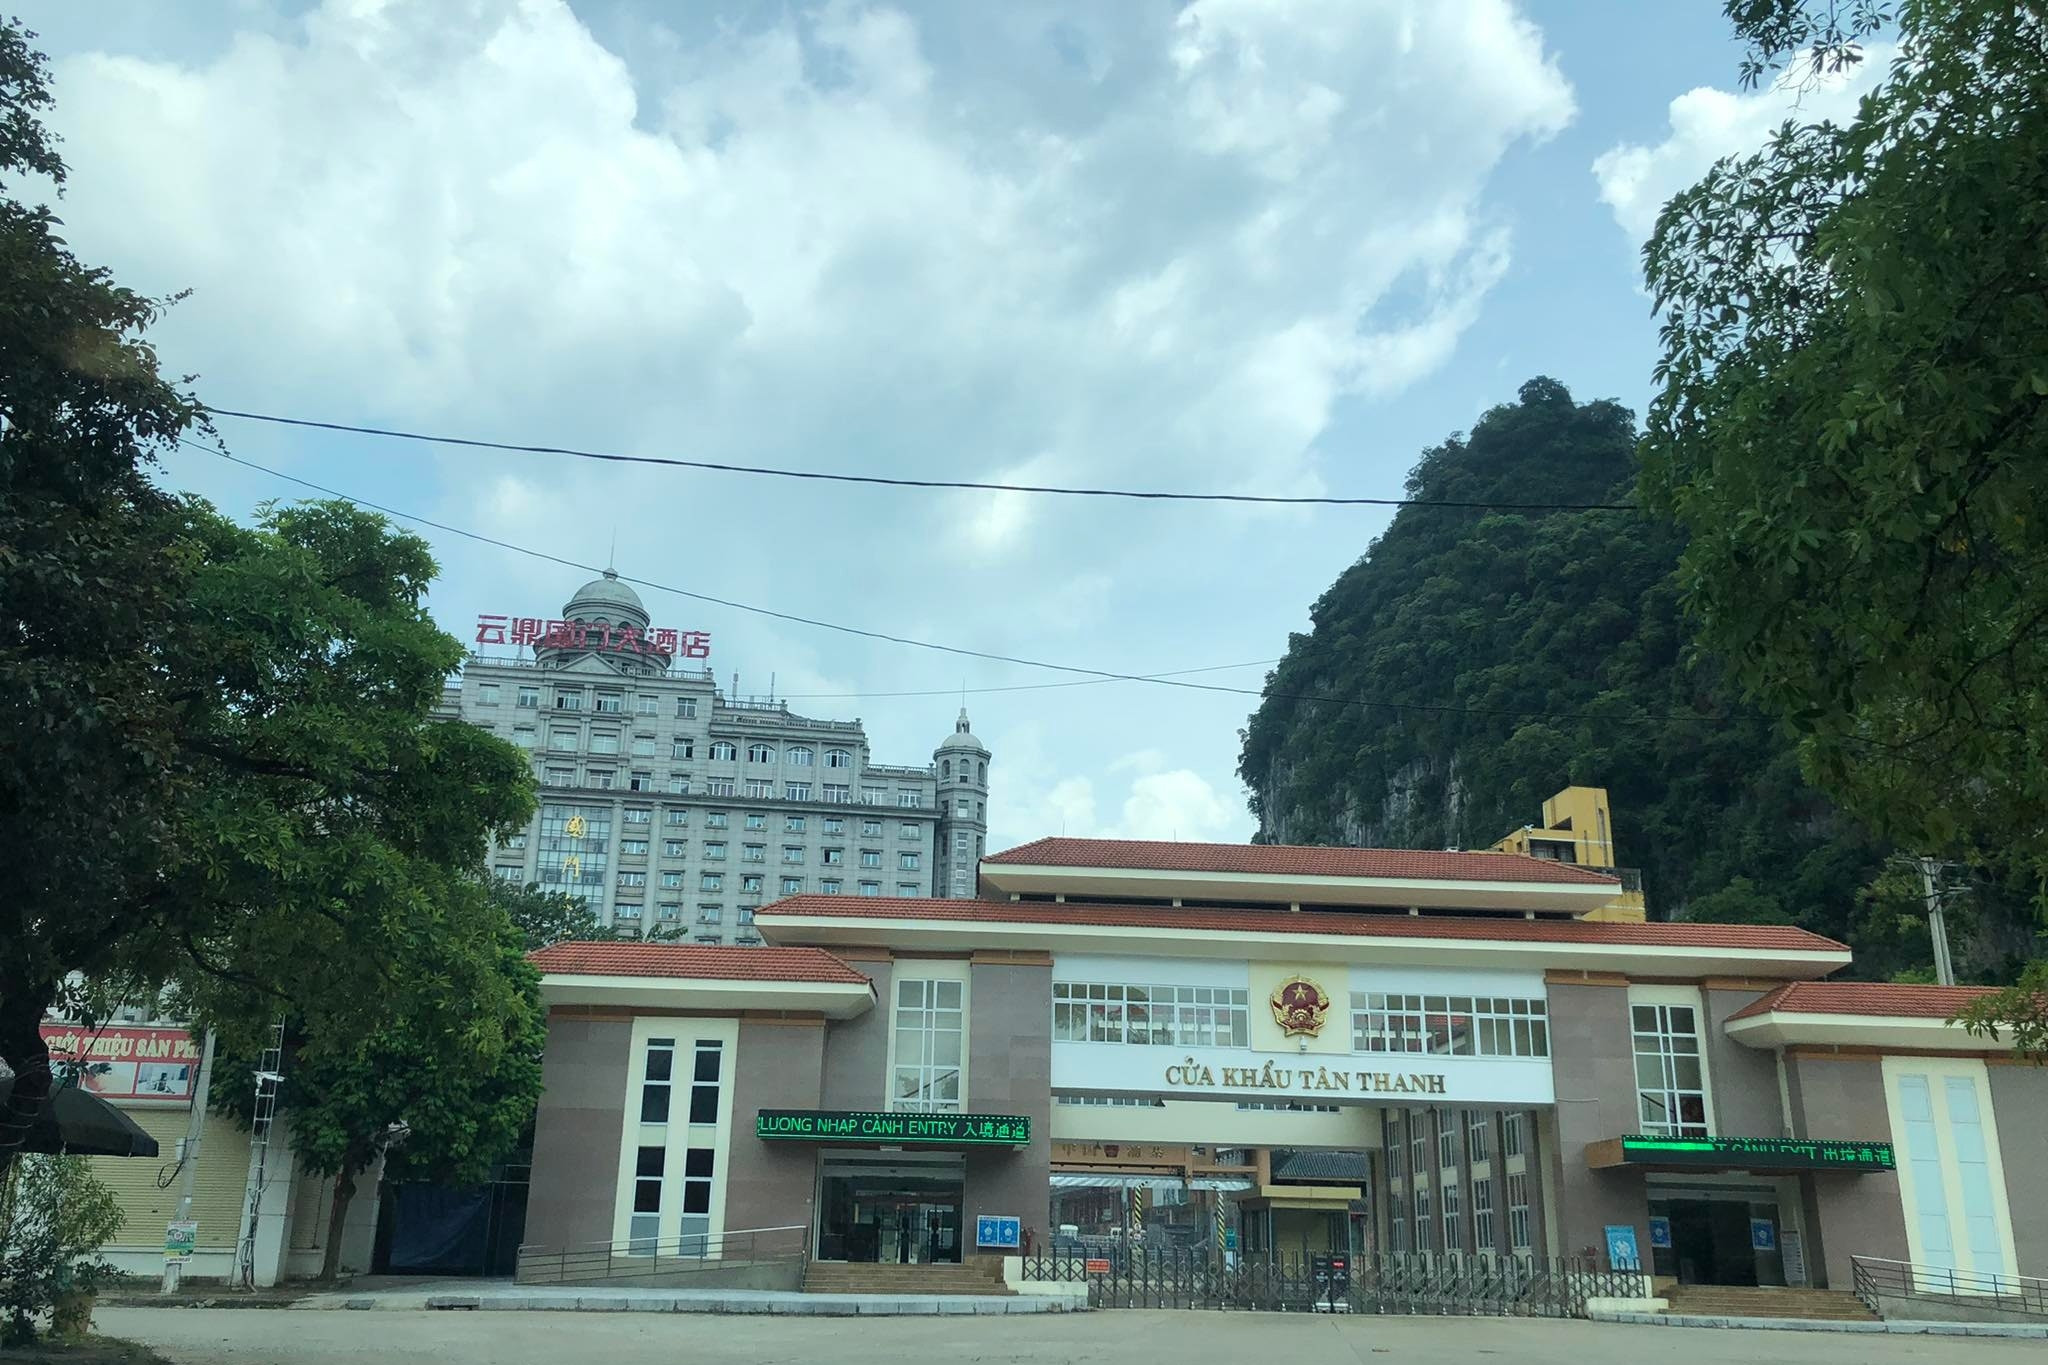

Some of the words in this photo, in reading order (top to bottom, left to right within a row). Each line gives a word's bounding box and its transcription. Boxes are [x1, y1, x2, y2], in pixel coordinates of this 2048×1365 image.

[83, 1032, 134, 1061] THIỆU
[135, 1032, 172, 1059] SẢN
[1165, 1056, 1215, 1086] CỬA
[1222, 1059, 1292, 1089] KHẨU
[1298, 1066, 1350, 1091] TÂN
[1356, 1072, 1447, 1094] THANH
[908, 1120, 957, 1136] ENTRY
[963, 1121, 1026, 1139] 入境通道
